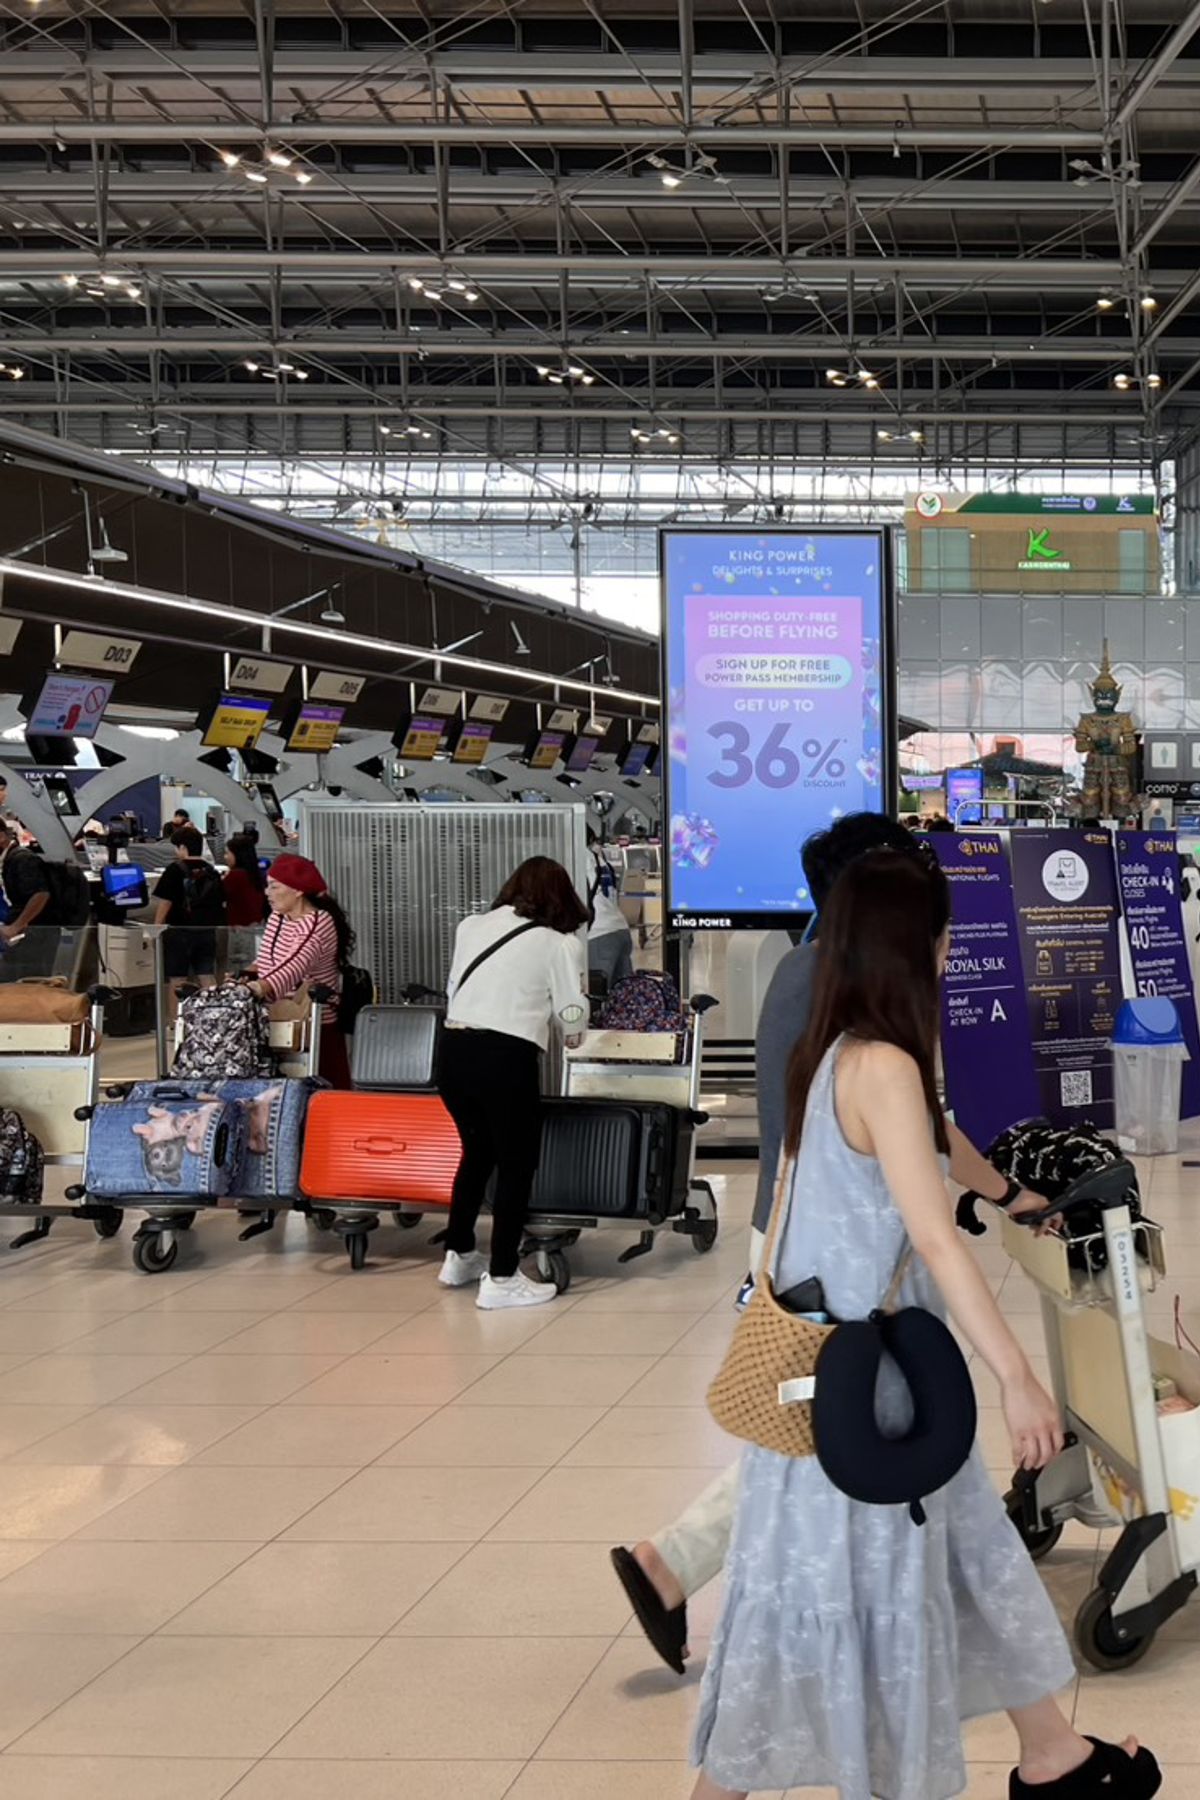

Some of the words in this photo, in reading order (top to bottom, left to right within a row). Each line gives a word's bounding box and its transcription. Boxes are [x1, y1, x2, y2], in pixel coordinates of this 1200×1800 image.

[729, 550, 764, 562] KING
[768, 550, 816, 562] POWER
[712, 566, 763, 577] DELIGHTS
[767, 566, 773, 577] &
[776, 566, 832, 577] SURPRISES
[708, 612, 770, 621] SHOPPING
[773, 612, 838, 622] DUTY-FREE
[708, 625, 774, 638] BEFORE
[779, 625, 838, 639] FLYING
[716, 659, 747, 669] SIGN
[750, 659, 769, 669] UP
[771, 659, 797, 670] FOR
[800, 660, 830, 670] FREE
[705, 673, 743, 683] POWER
[746, 673, 771, 683] PASS
[774, 673, 841, 683] MEMBERSHIP
[734, 699, 764, 712] GET
[768, 699, 791, 712] UP
[793, 699, 814, 712] TO
[803, 779, 847, 788] DISCOUNT
[1145, 784, 1178, 794] COTTO
[971, 840, 999, 853] THAI
[1122, 876, 1159, 887] CHECK-IN
[672, 919, 696, 927] KING
[699, 919, 731, 927] POWER
[1131, 926, 1150, 949] 40
[944, 958, 982, 973] ROYAL
[982, 956, 1006, 971] SILK
[1138, 979, 1158, 997] 50
[948, 1007, 983, 1017] CHECK-IN
[990, 998, 1007, 1022] A
